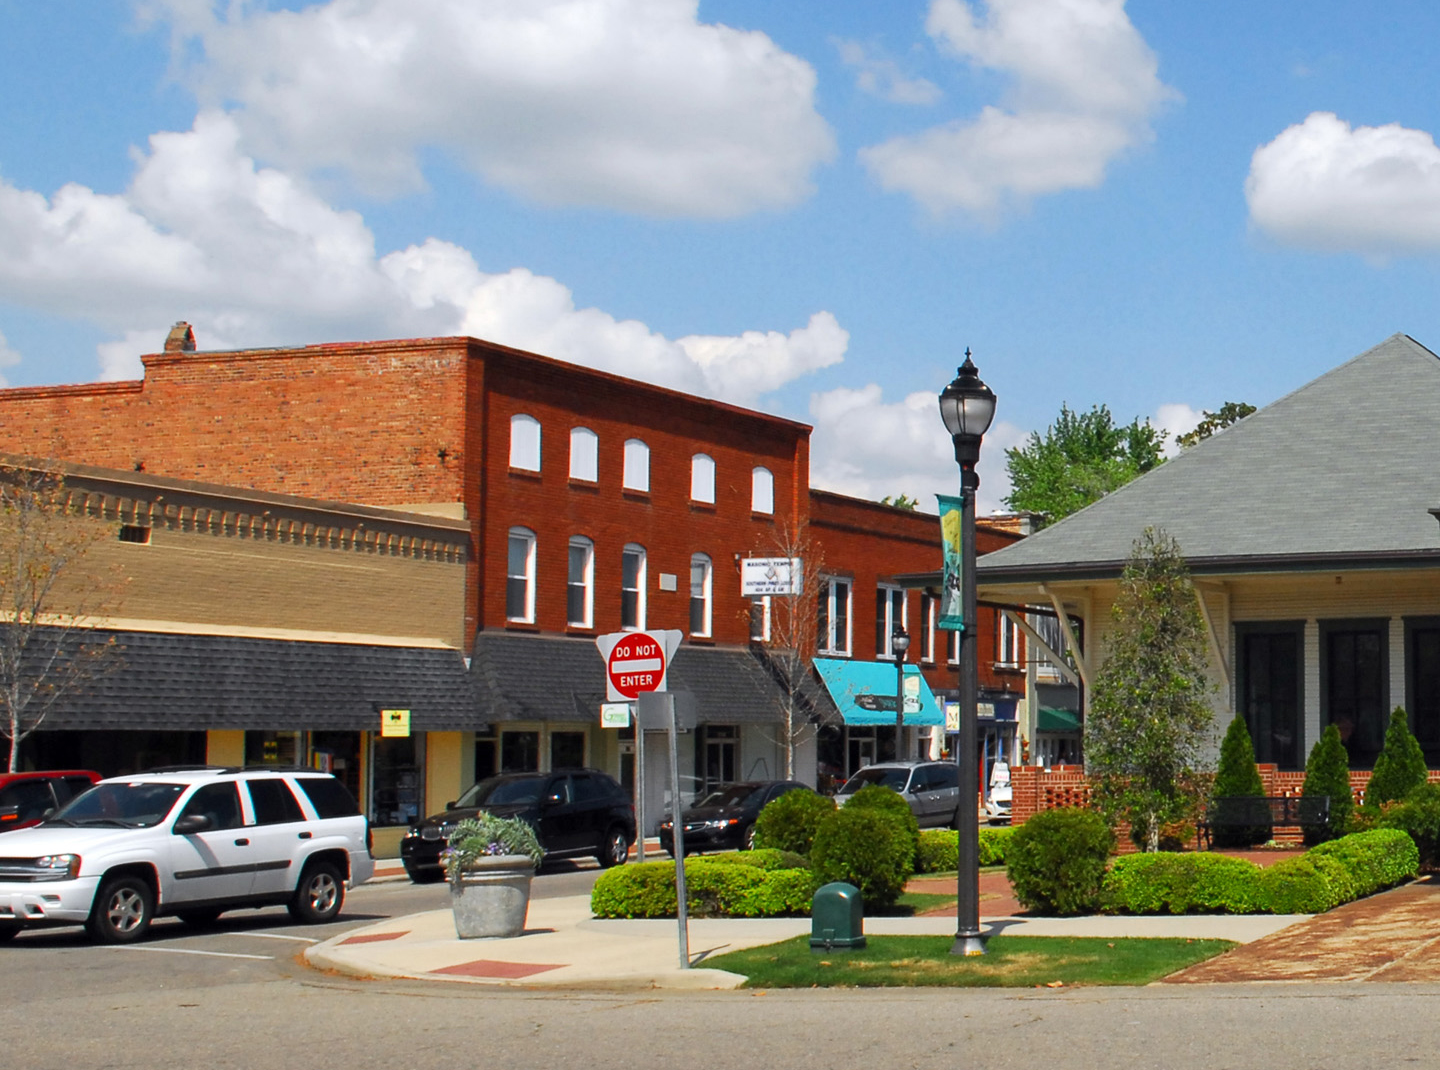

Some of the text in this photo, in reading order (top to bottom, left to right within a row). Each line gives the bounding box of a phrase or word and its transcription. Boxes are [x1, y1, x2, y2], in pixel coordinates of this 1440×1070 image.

[616, 644, 656, 658] DO NOT
[620, 674, 653, 687] ENTER
